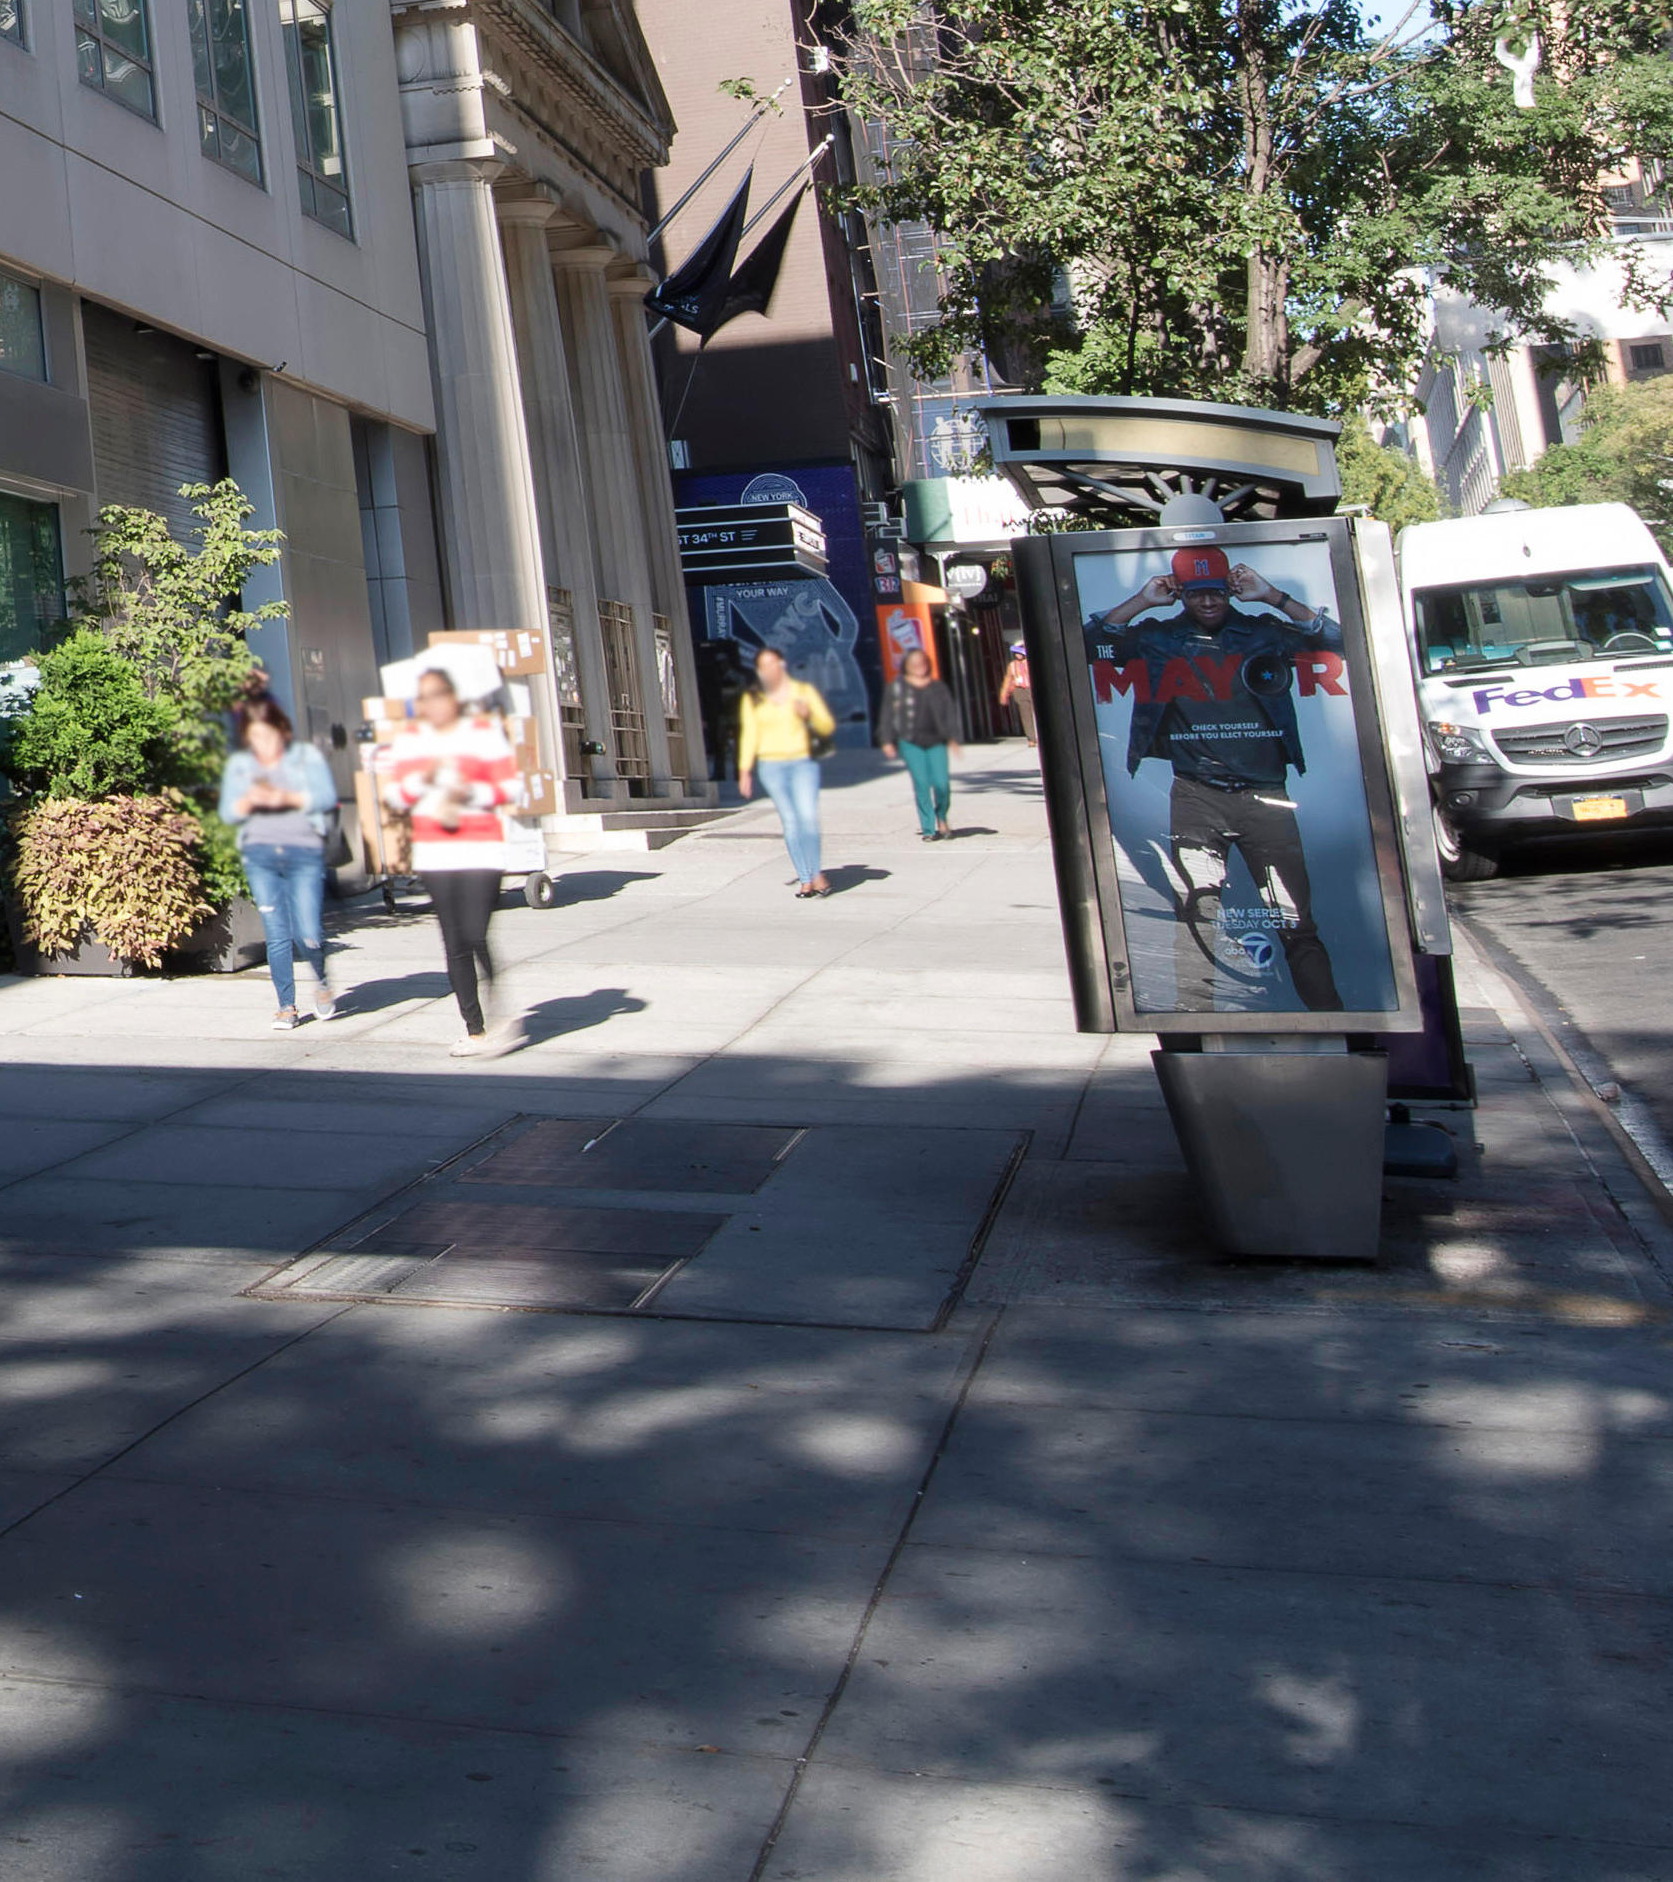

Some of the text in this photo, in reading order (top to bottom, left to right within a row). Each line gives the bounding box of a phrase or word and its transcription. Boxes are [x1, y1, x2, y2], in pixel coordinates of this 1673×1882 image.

[770, 492, 793, 502] YORK
[719, 531, 736, 542] ST
[1194, 558, 1211, 576] M
[736, 587, 789, 599] YOUR WAY
[1095, 643, 1115, 659] THE
[1472, 676, 1662, 715] FedEx
[1191, 721, 1260, 732] CHECK YOURSELF
[1170, 729, 1284, 742] BEFORE YOU ELECT YOURSELF
[1216, 908, 1245, 919] NEW
[1262, 919, 1287, 929] OCT
